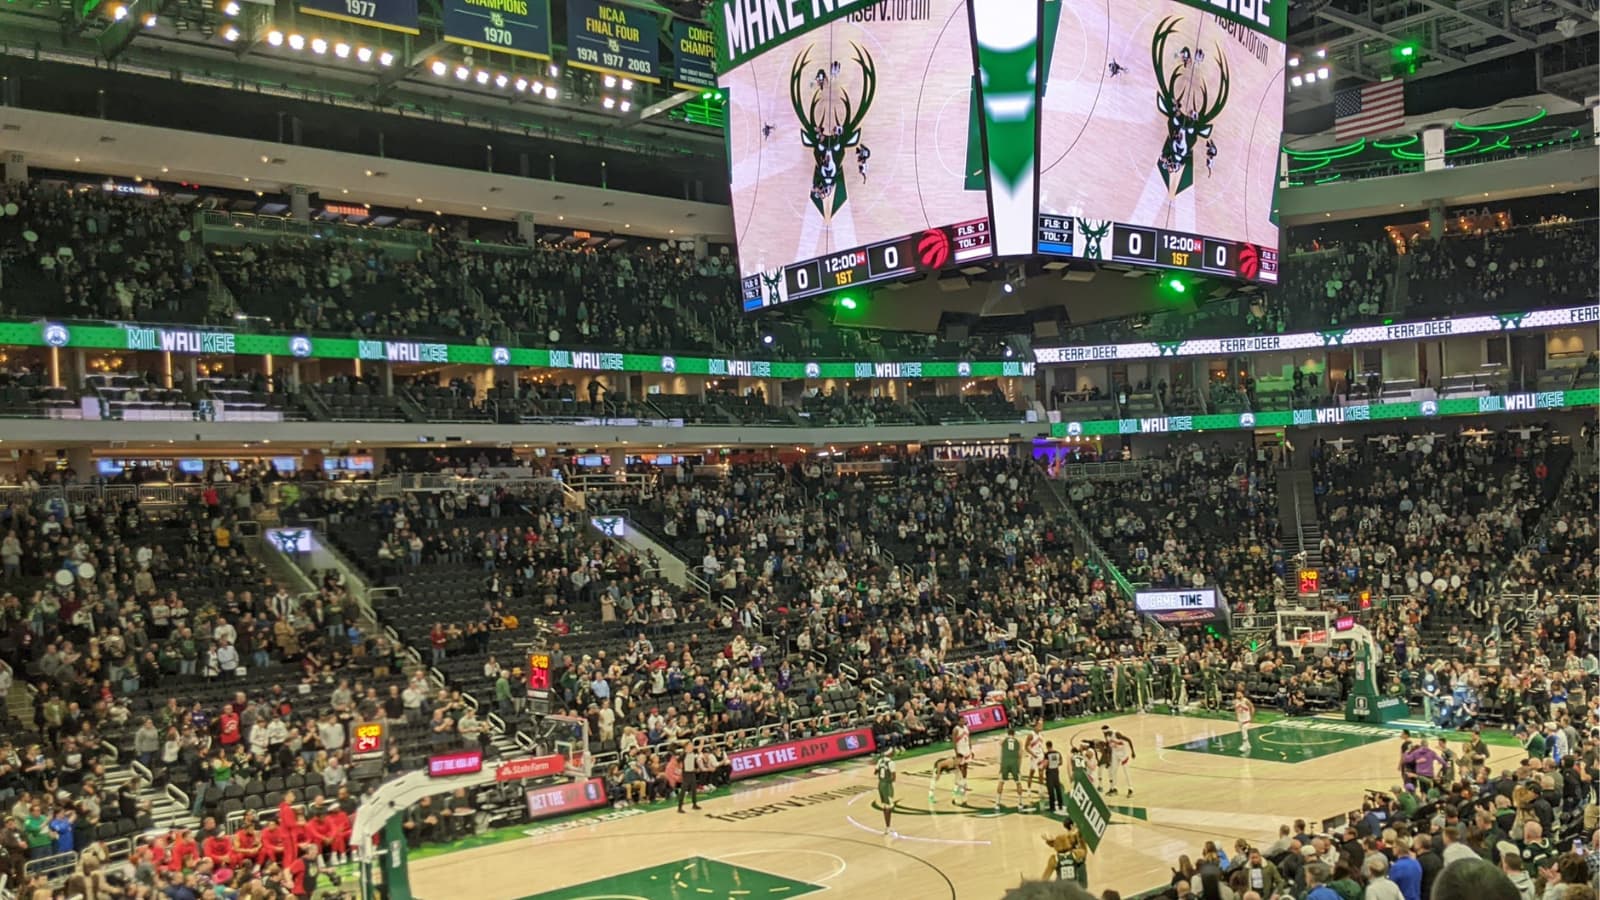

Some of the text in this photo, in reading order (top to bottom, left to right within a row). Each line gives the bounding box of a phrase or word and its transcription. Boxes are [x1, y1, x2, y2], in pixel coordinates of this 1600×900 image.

[345, 0, 375, 17] 1977
[599, 6, 625, 24] NCAA
[484, 27, 512, 46] 1970
[586, 18, 639, 43] FINAL FOUR
[577, 47, 650, 74] 1974 1977 2003
[959, 235, 985, 248] TOL: 7
[1043, 232, 1068, 242] TOL: 7
[1129, 233, 1141, 255] 0
[1163, 234, 1193, 251] 12:00
[1216, 246, 1226, 266] 0
[1172, 251, 1188, 266] 1ST
[797, 269, 808, 289] 0
[825, 253, 856, 272] 12:00
[884, 246, 898, 268] 0
[835, 270, 853, 285] 1ST
[1571, 307, 1600, 321] FEAR
[1388, 325, 1415, 338] FEAR
[1425, 321, 1452, 335] DEER
[128, 328, 235, 353] MILWAUKEE
[1220, 338, 1246, 351] FEAR
[1254, 337, 1280, 350] DEER
[359, 341, 448, 362] MILWAUKEE
[549, 350, 624, 370] MILWAUKEE
[1059, 348, 1084, 360] FEAR
[1092, 346, 1117, 358] DEER
[709, 359, 771, 376] MILWAUKEE
[854, 362, 922, 378] MILWAUKEE
[1480, 391, 1564, 412] MILWAUKEE
[1293, 405, 1369, 424] MILWAUKEE
[1120, 416, 1192, 432] MILWAUKEE
[1180, 594, 1202, 606] TIME
[359, 737, 376, 749] 24
[732, 742, 829, 771] GET THE APP
[1084, 800, 1106, 838] LOUD
